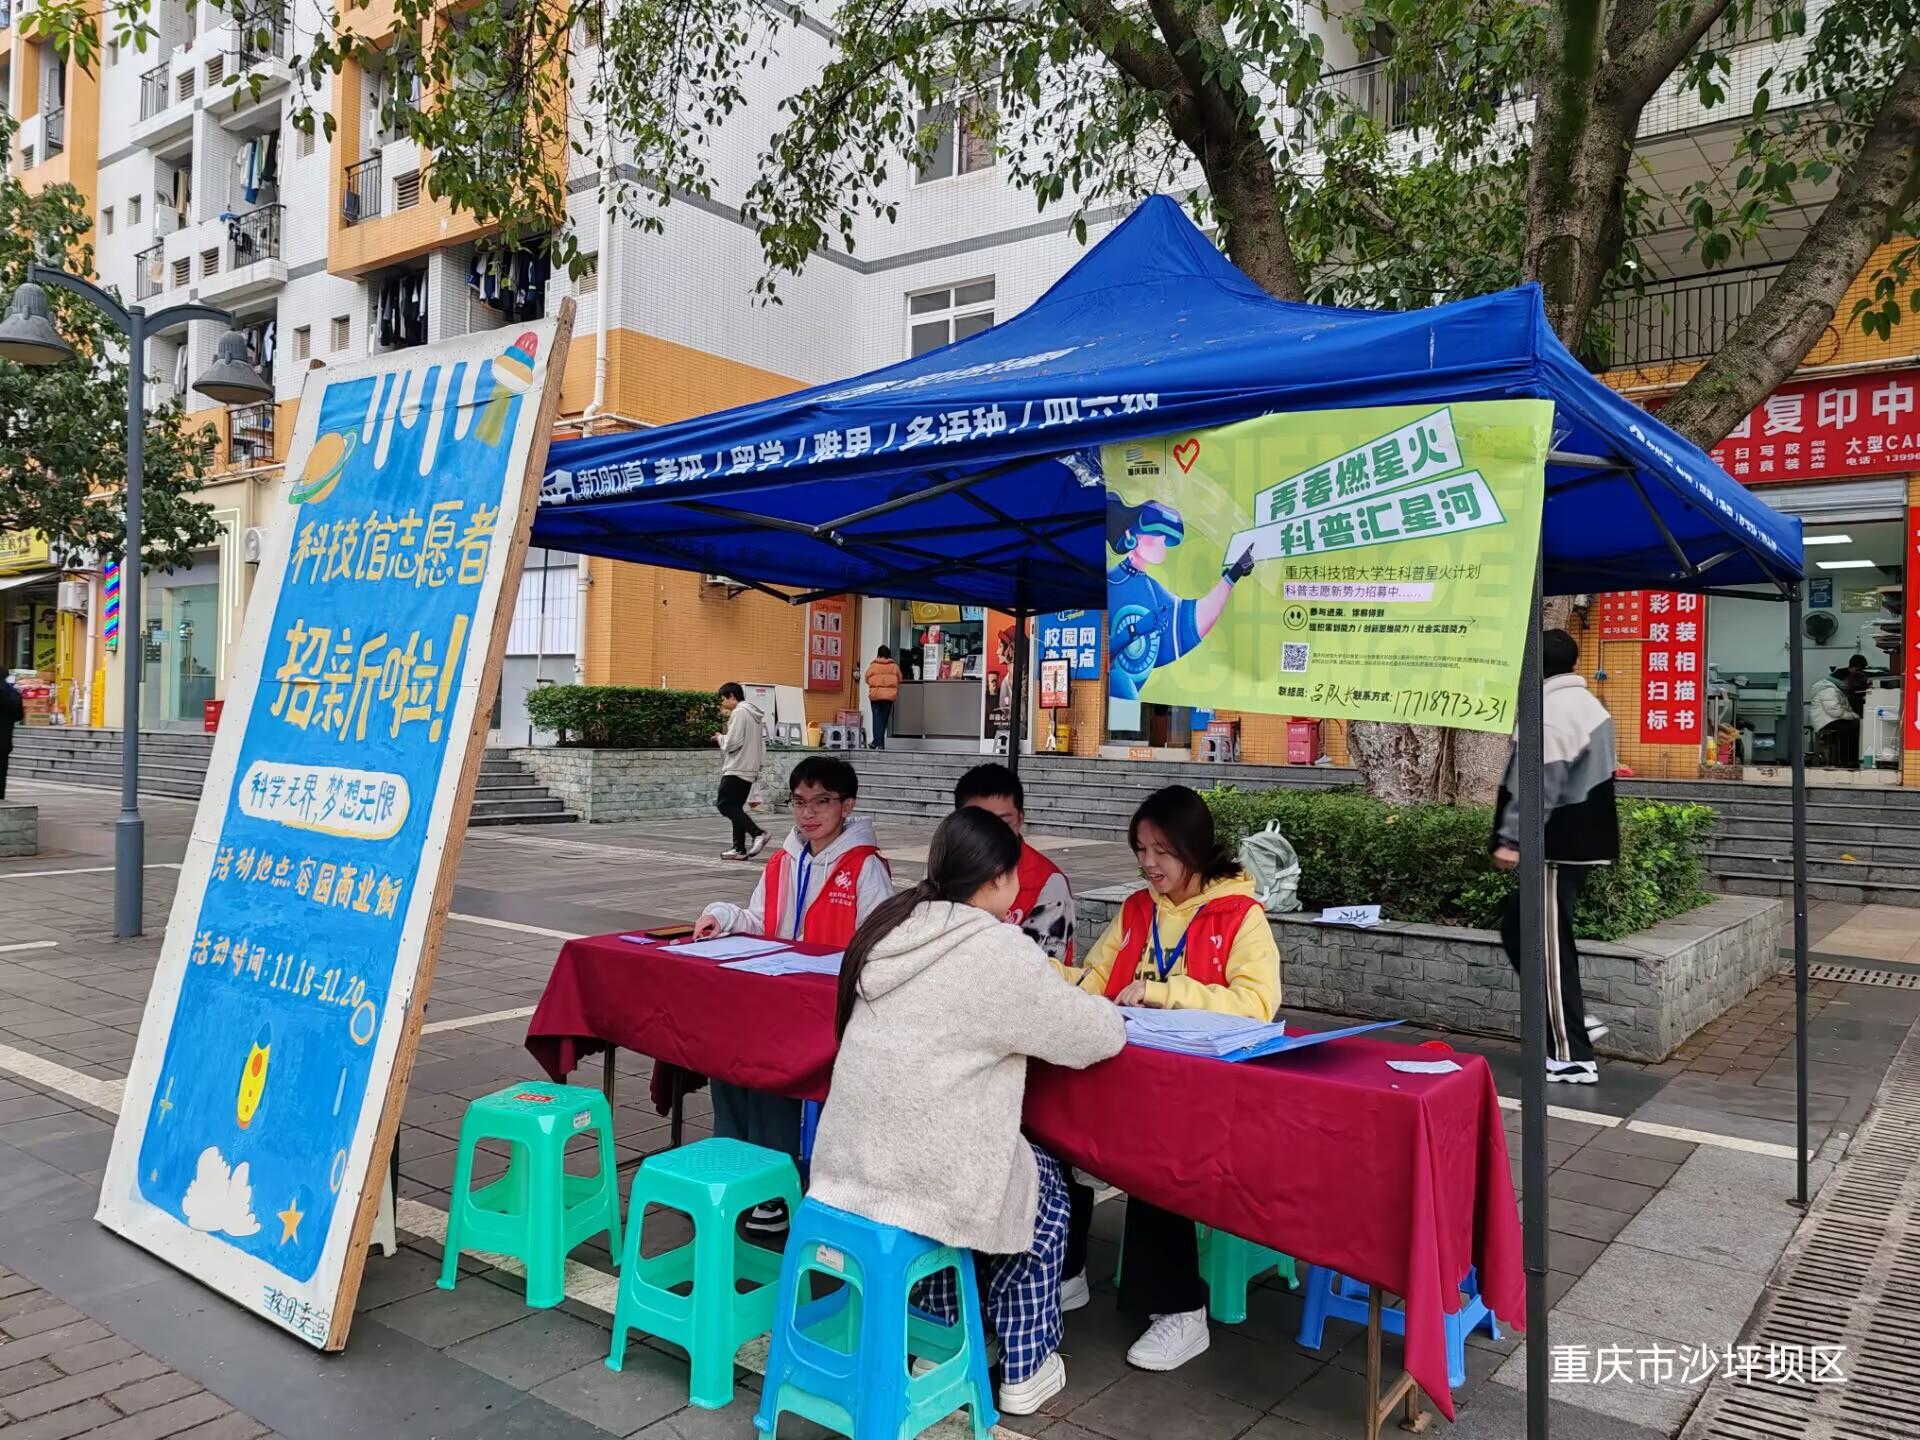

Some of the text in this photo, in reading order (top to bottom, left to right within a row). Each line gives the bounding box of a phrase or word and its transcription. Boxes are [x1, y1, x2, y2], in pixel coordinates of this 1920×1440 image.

[1735, 447, 1750, 475] 扫描
[1760, 444, 1775, 472] 写真
[1785, 442, 1801, 471] 胶装
[576, 460, 645, 495] 新航道
[1269, 425, 1448, 520] 青春燃星火
[1280, 483, 1483, 555] 科普汇星河
[290, 501, 499, 589] 科技馆志愿者
[1284, 564, 1481, 581] 重庆科技馆大学生科普星火计划
[1649, 593, 1697, 613] 彩印
[1044, 627, 1096, 648] 校园网
[1650, 622, 1697, 642] 胶装
[1649, 652, 1696, 672] 照相
[270, 614, 469, 743] 招新啦!
[1648, 680, 1696, 701] 扫描
[1647, 710, 1695, 730] 标书
